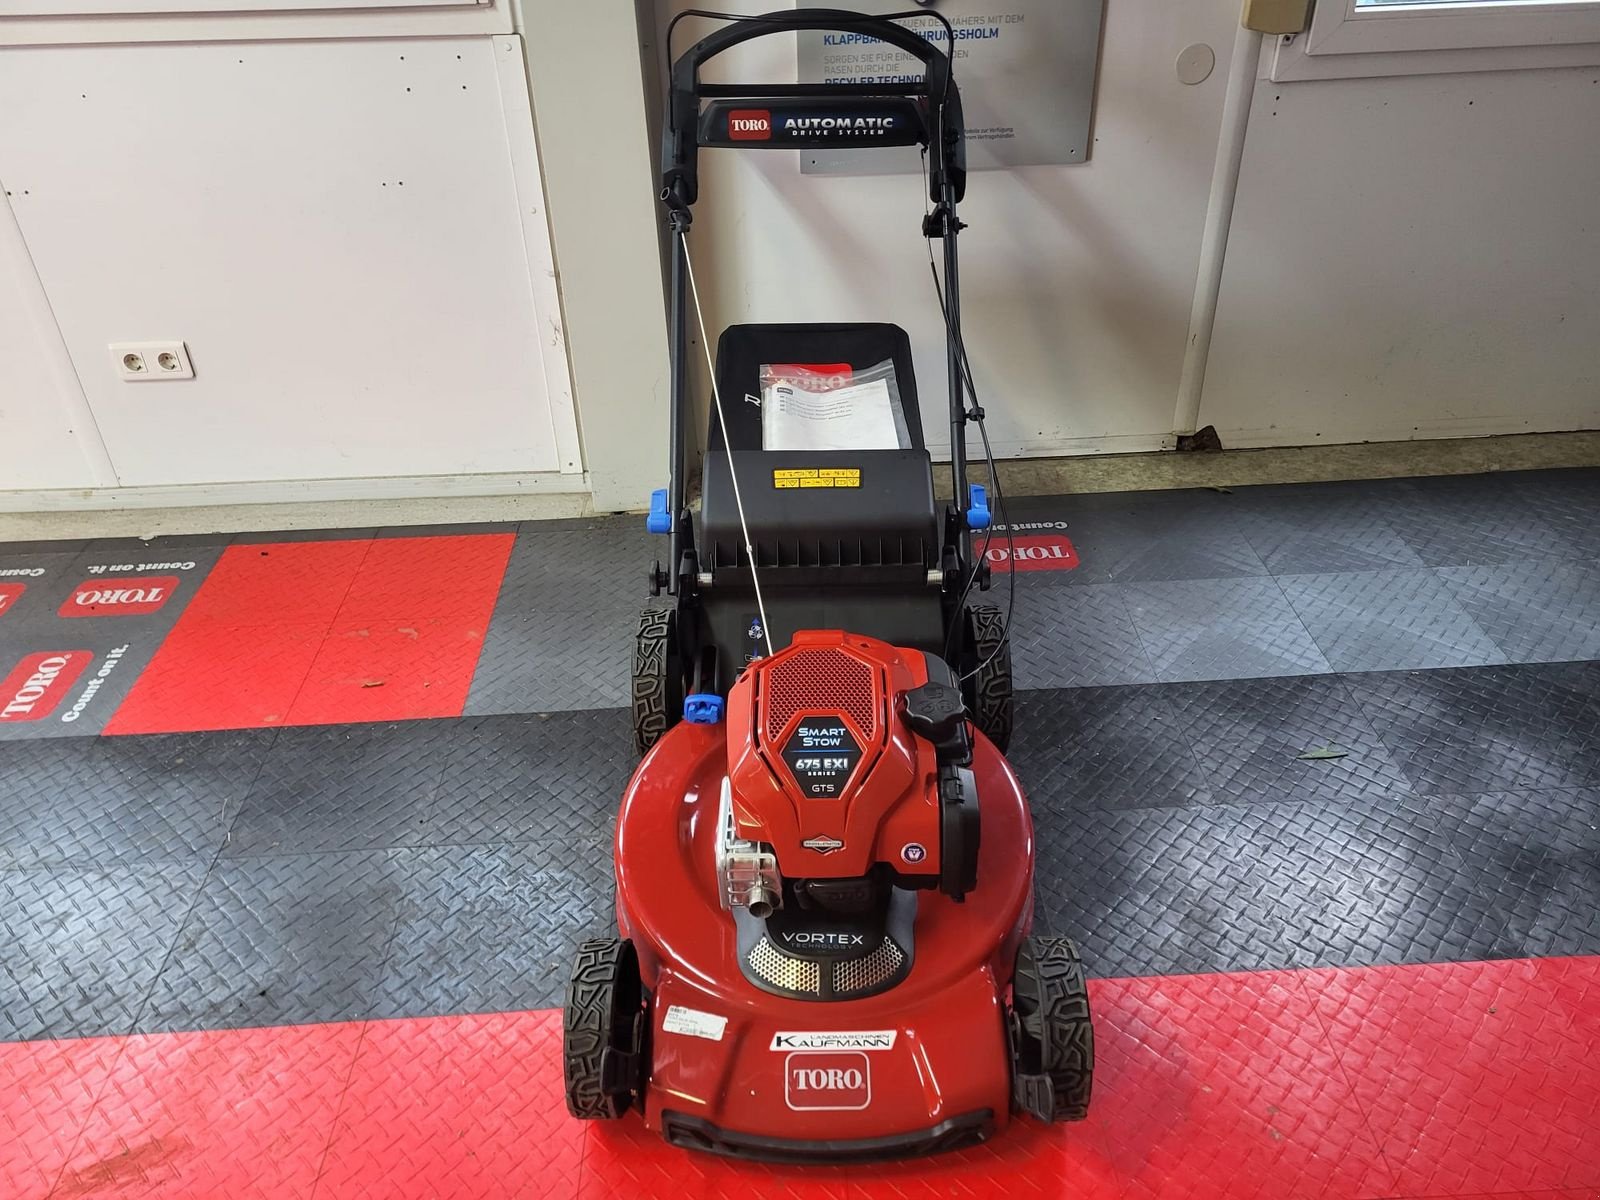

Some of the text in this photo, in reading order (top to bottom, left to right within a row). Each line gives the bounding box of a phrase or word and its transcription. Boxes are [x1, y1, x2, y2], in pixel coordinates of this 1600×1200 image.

[988, 15, 1002, 24] MIT
[1005, 14, 1025, 24] DEM
[823, 55, 859, 65] SORGEN
[861, 53, 874, 63] SIE
[824, 63, 900, 75] RASEN DURCH DIE
[732, 118, 893, 131] TORO AUTOMATIC
[1011, 521, 1068, 531] Count
[985, 545, 1070, 562] TORO
[88, 561, 196, 574] Count on it.
[75, 587, 164, 606] TORO
[61, 643, 129, 722] Count on it.
[798, 727, 846, 736] SMART
[803, 737, 841, 747] STOW
[796, 758, 848, 769] 675 EXI
[811, 784, 835, 792] GTS
[781, 932, 864, 945] VORTEX
[776, 1035, 890, 1048] KAUFMANN
[793, 1069, 863, 1091] TORO
